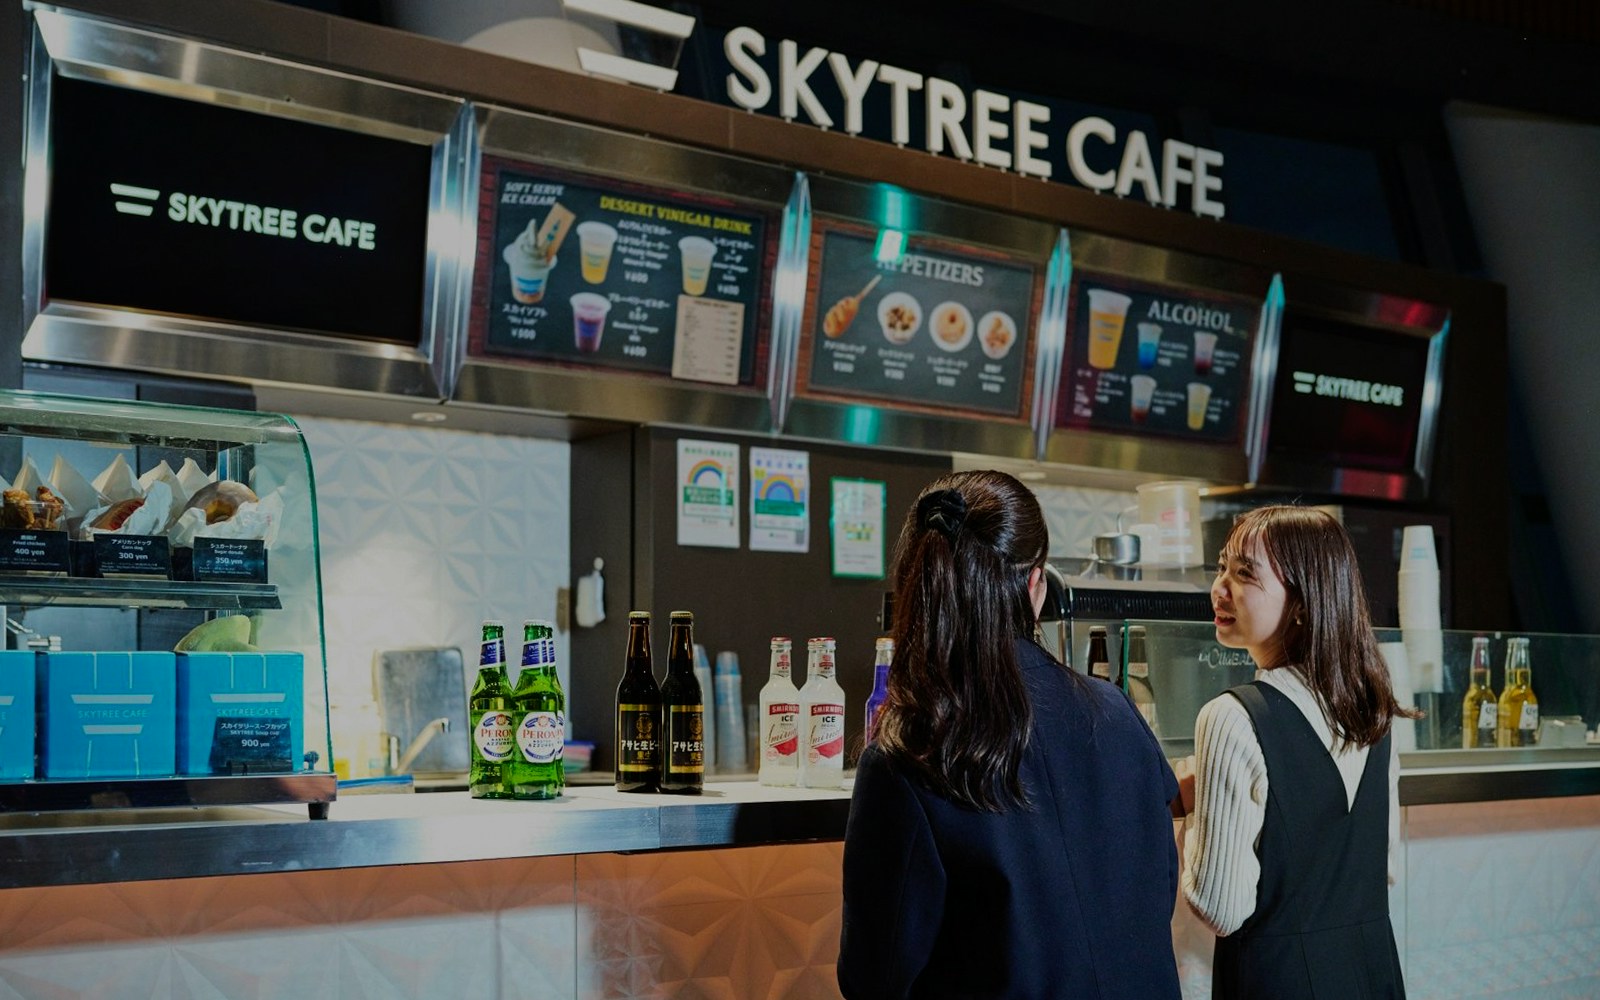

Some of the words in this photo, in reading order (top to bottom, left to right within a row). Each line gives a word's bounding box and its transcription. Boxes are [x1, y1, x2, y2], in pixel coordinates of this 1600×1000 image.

[723, 26, 1052, 178] SKYTREE
[1066, 116, 1225, 217] CAFE
[504, 181, 532, 194] SOFT
[532, 183, 566, 197] SERVE
[501, 193, 519, 204] ICE
[519, 194, 558, 206] CREAM
[168, 192, 298, 239] SKYTREE
[302, 213, 377, 250] CAFE
[600, 195, 654, 218] DESSERT
[657, 206, 712, 228] VINEGAR
[713, 216, 752, 235] DRINK
[1147, 300, 1235, 335] ALCOHOL
[1315, 374, 1370, 402] SKYTREE
[1370, 382, 1404, 407] CAFE
[111, 538, 152, 547] アメリカンドッグ
[134, 553, 148, 561] yen
[215, 556, 230, 564] 350
[231, 558, 243, 566] yen
[79, 709, 120, 719] SKYTREE
[122, 709, 149, 719] CAFE
[217, 708, 257, 717] SKYTREE
[259, 707, 281, 716] CAFE
[241, 739, 259, 747] 900
[621, 740, 659, 751] アサヒ生ビー
